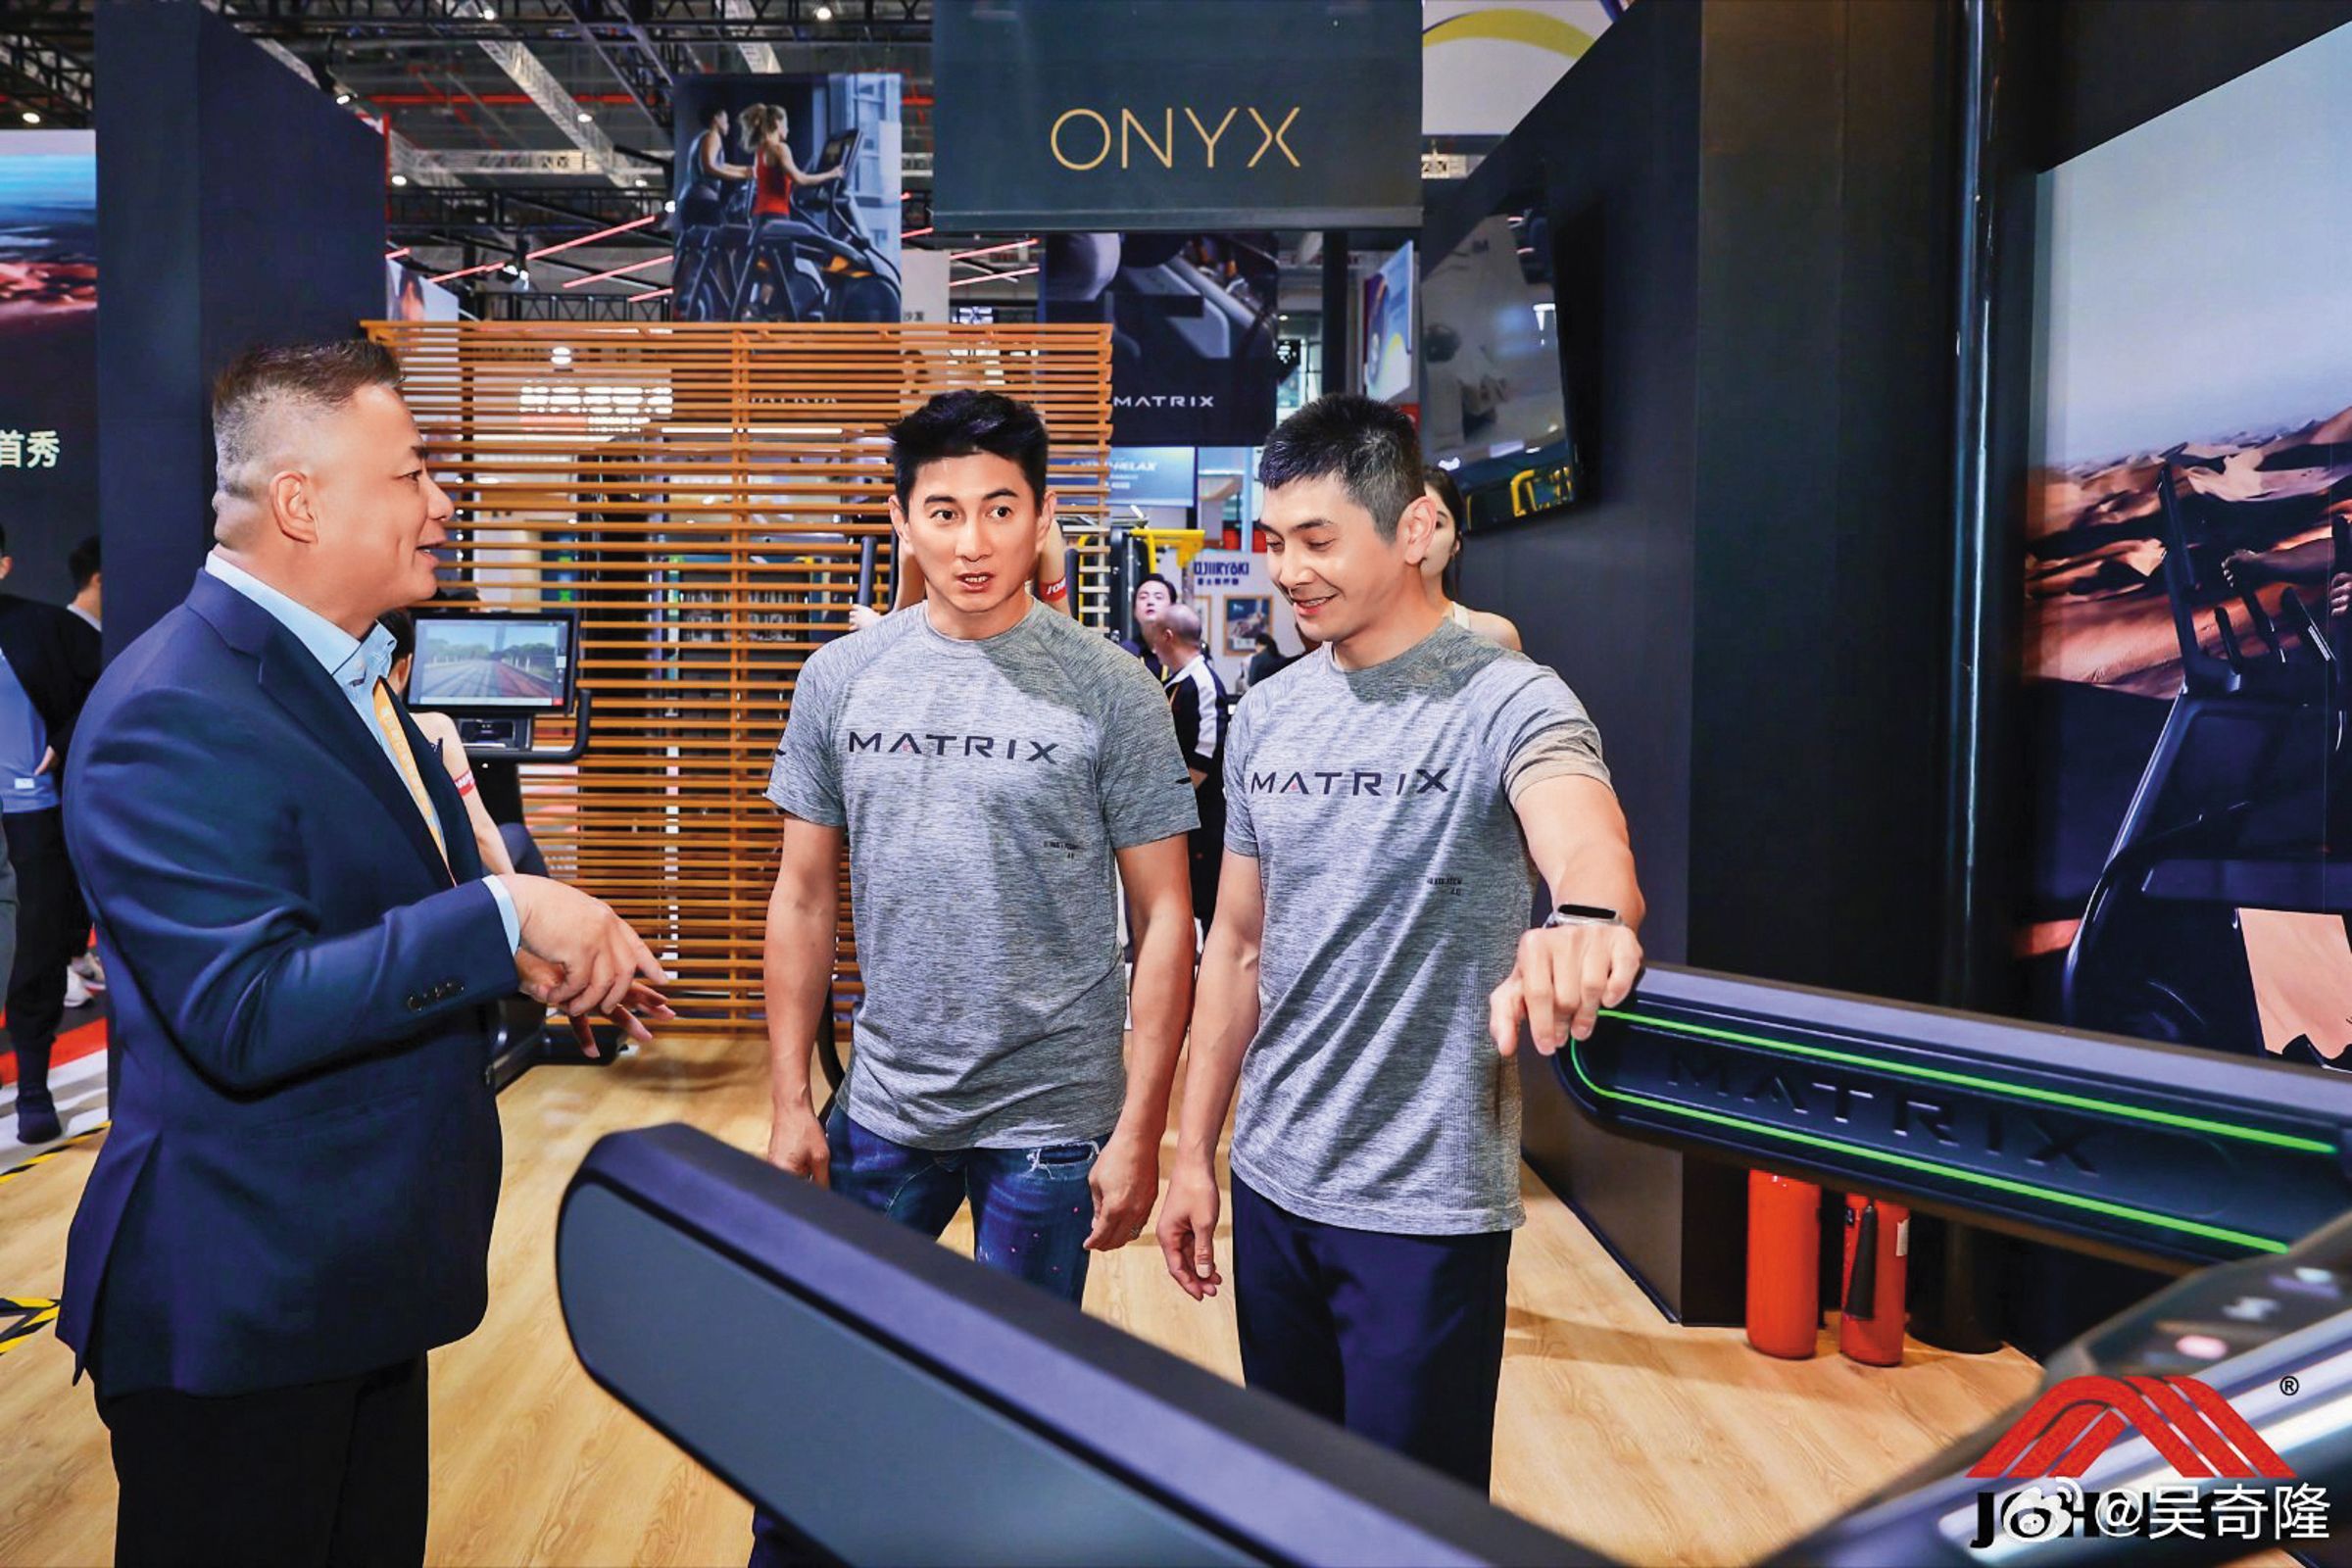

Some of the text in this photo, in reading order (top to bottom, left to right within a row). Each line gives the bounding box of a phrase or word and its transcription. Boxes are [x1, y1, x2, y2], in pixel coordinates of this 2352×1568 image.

[1051, 107, 1301, 171] ONYX
[1113, 396, 1214, 408] MATRIX
[0, 429, 61, 468] 首秀
[849, 731, 1059, 764] MATRIX
[1250, 768, 1450, 796] MATRIX
[1667, 1054, 2100, 1177] MATRIX
